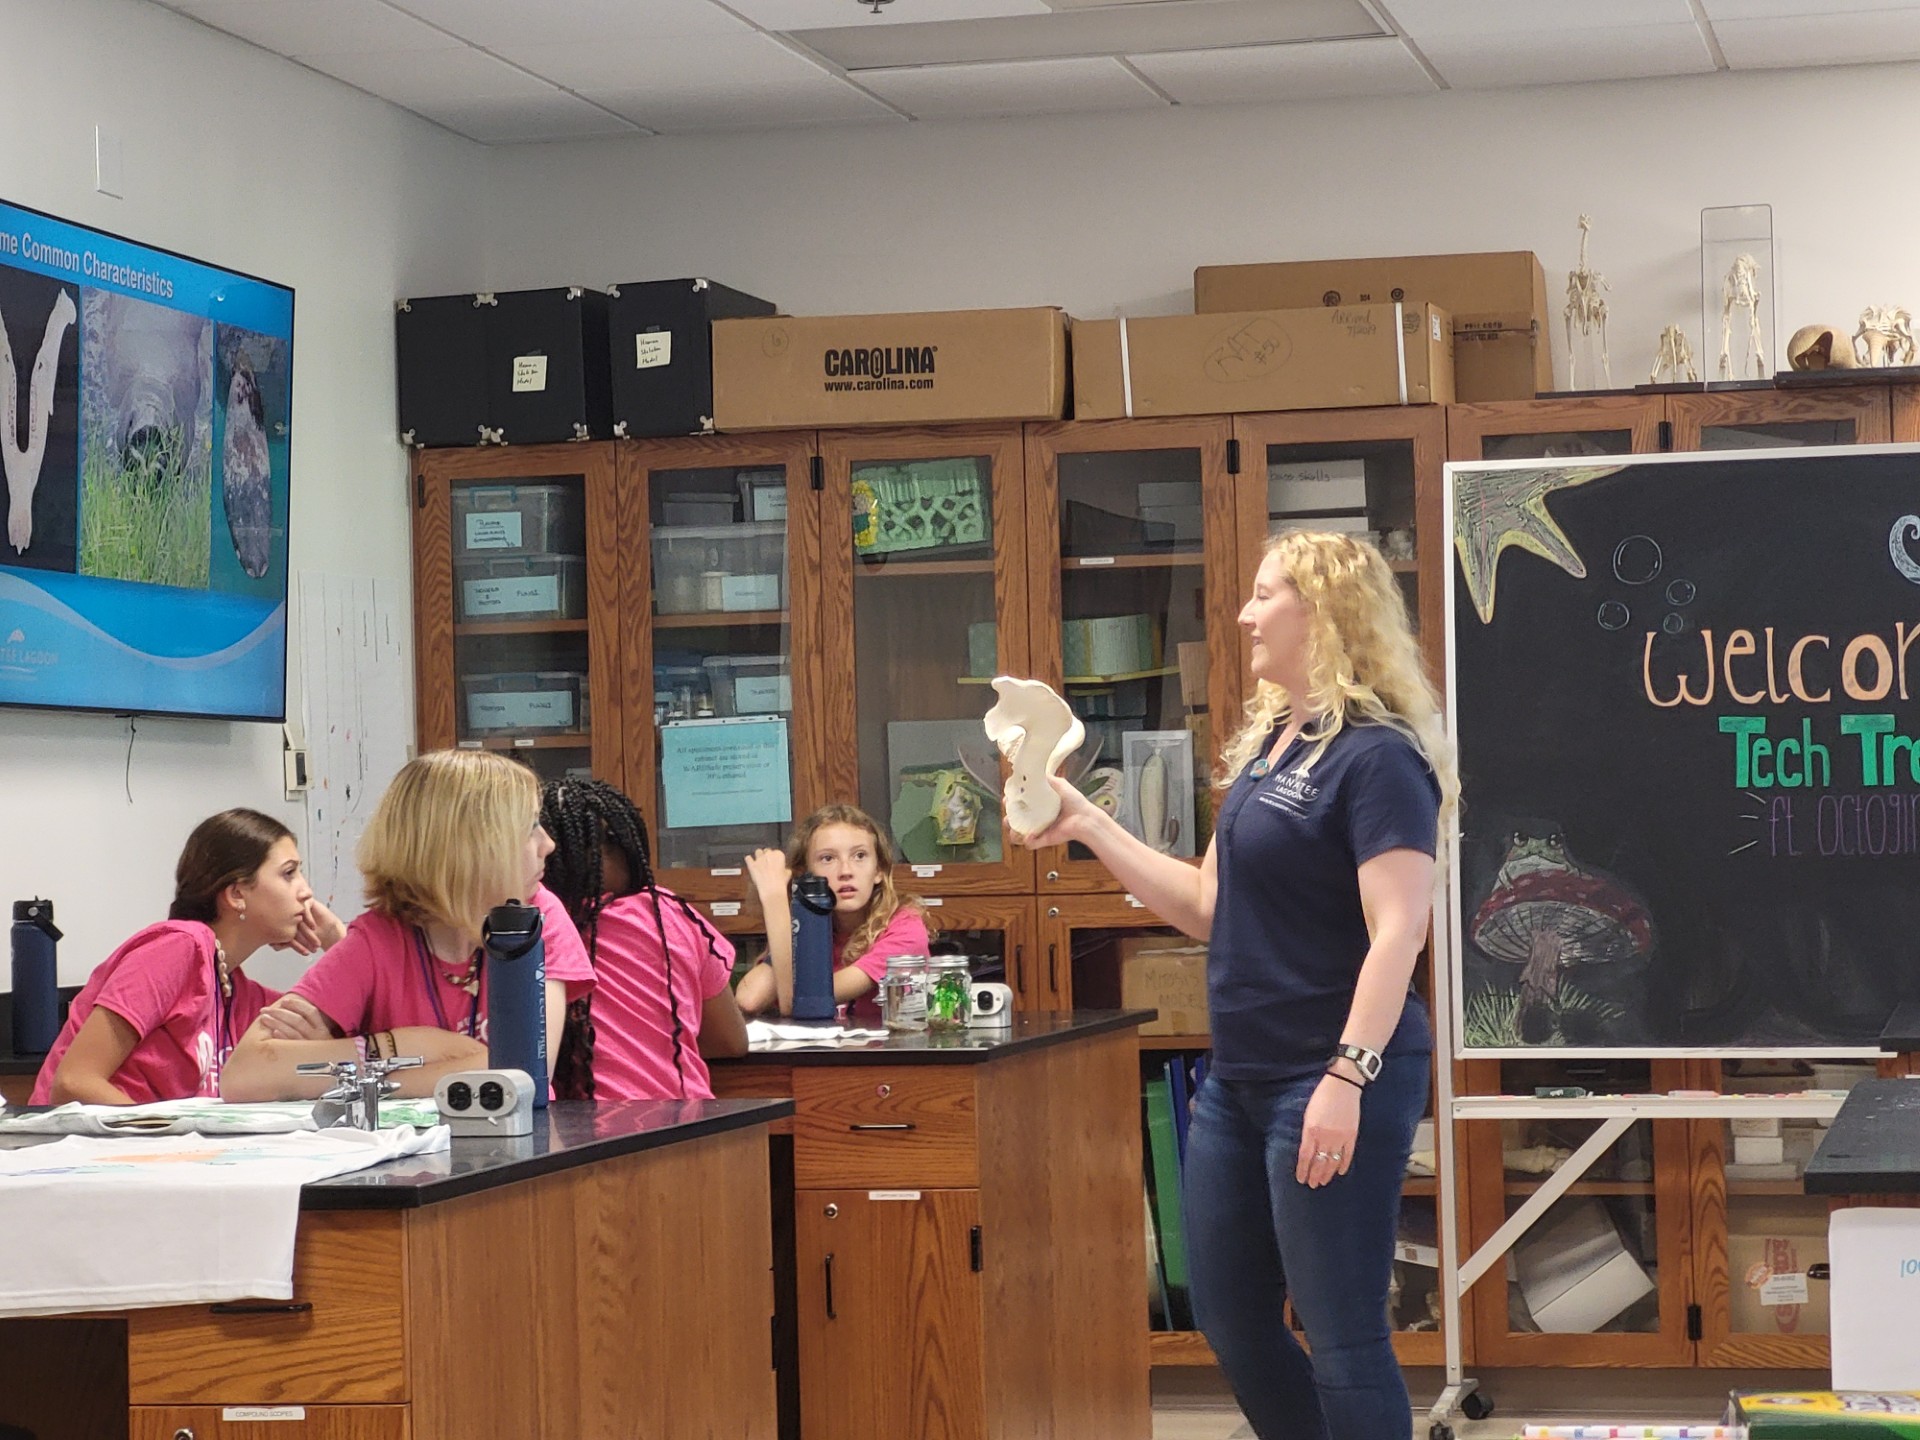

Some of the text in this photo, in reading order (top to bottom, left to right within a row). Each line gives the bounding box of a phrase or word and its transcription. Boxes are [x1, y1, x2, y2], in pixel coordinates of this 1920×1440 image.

[22, 232, 80, 272] Common
[83, 250, 174, 299] Characteristics
[824, 378, 935, 393] www.carolina.com
[1718, 716, 1831, 789] Tech
